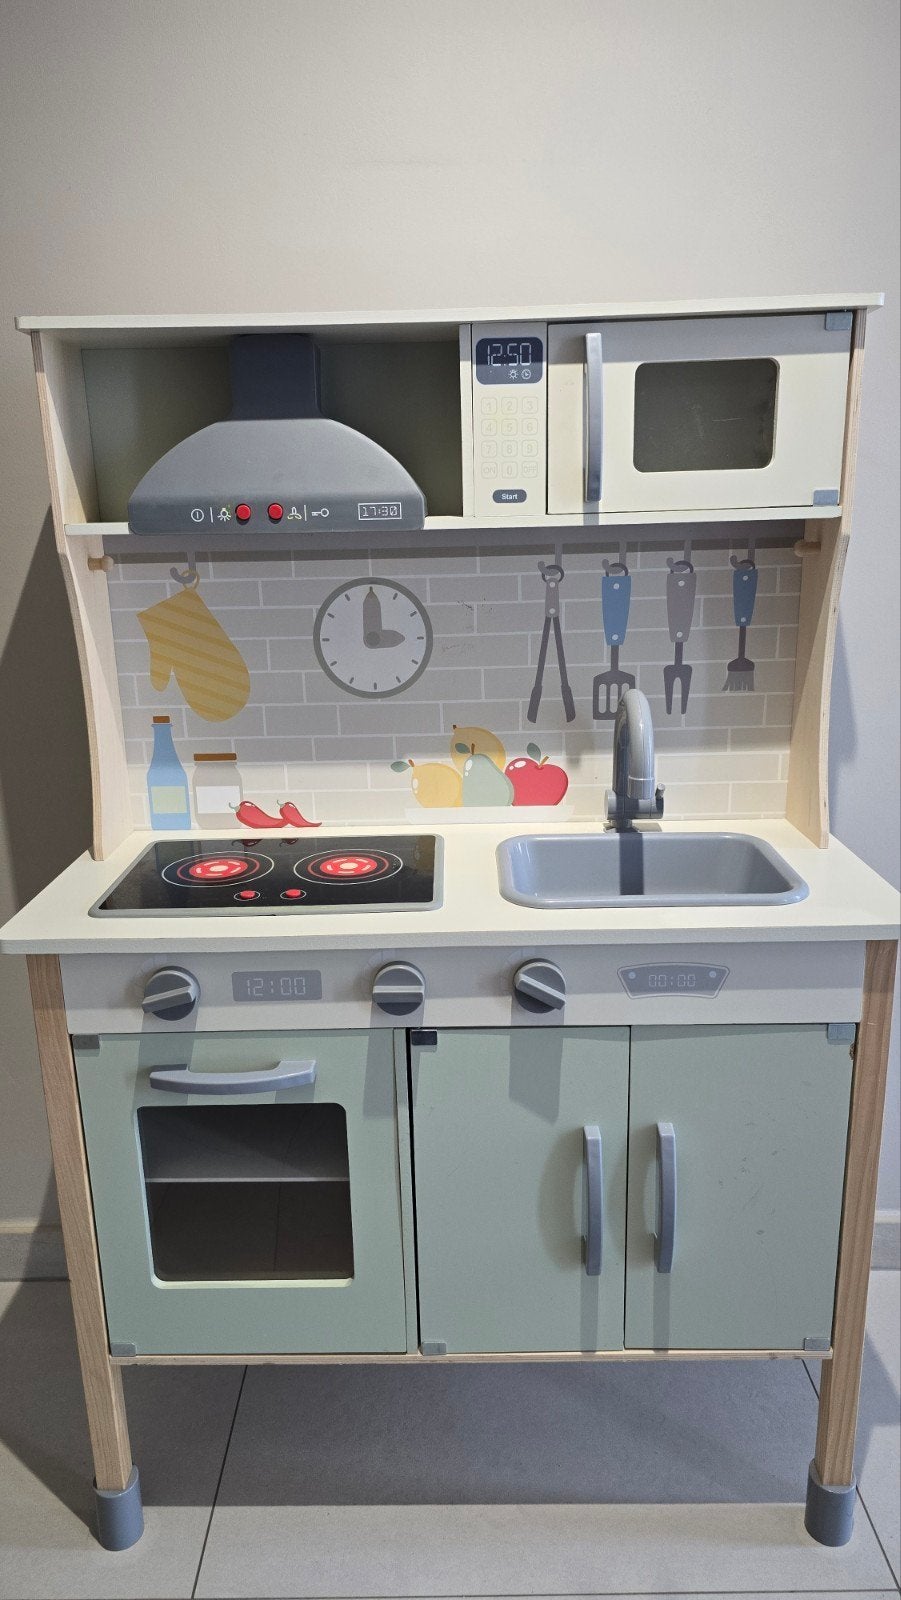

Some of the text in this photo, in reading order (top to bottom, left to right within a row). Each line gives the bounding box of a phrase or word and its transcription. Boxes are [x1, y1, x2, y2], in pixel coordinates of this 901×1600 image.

[362, 505, 398, 517] 17:30
[247, 977, 306, 996] 12:00
[649, 974, 696, 987] 00:00
